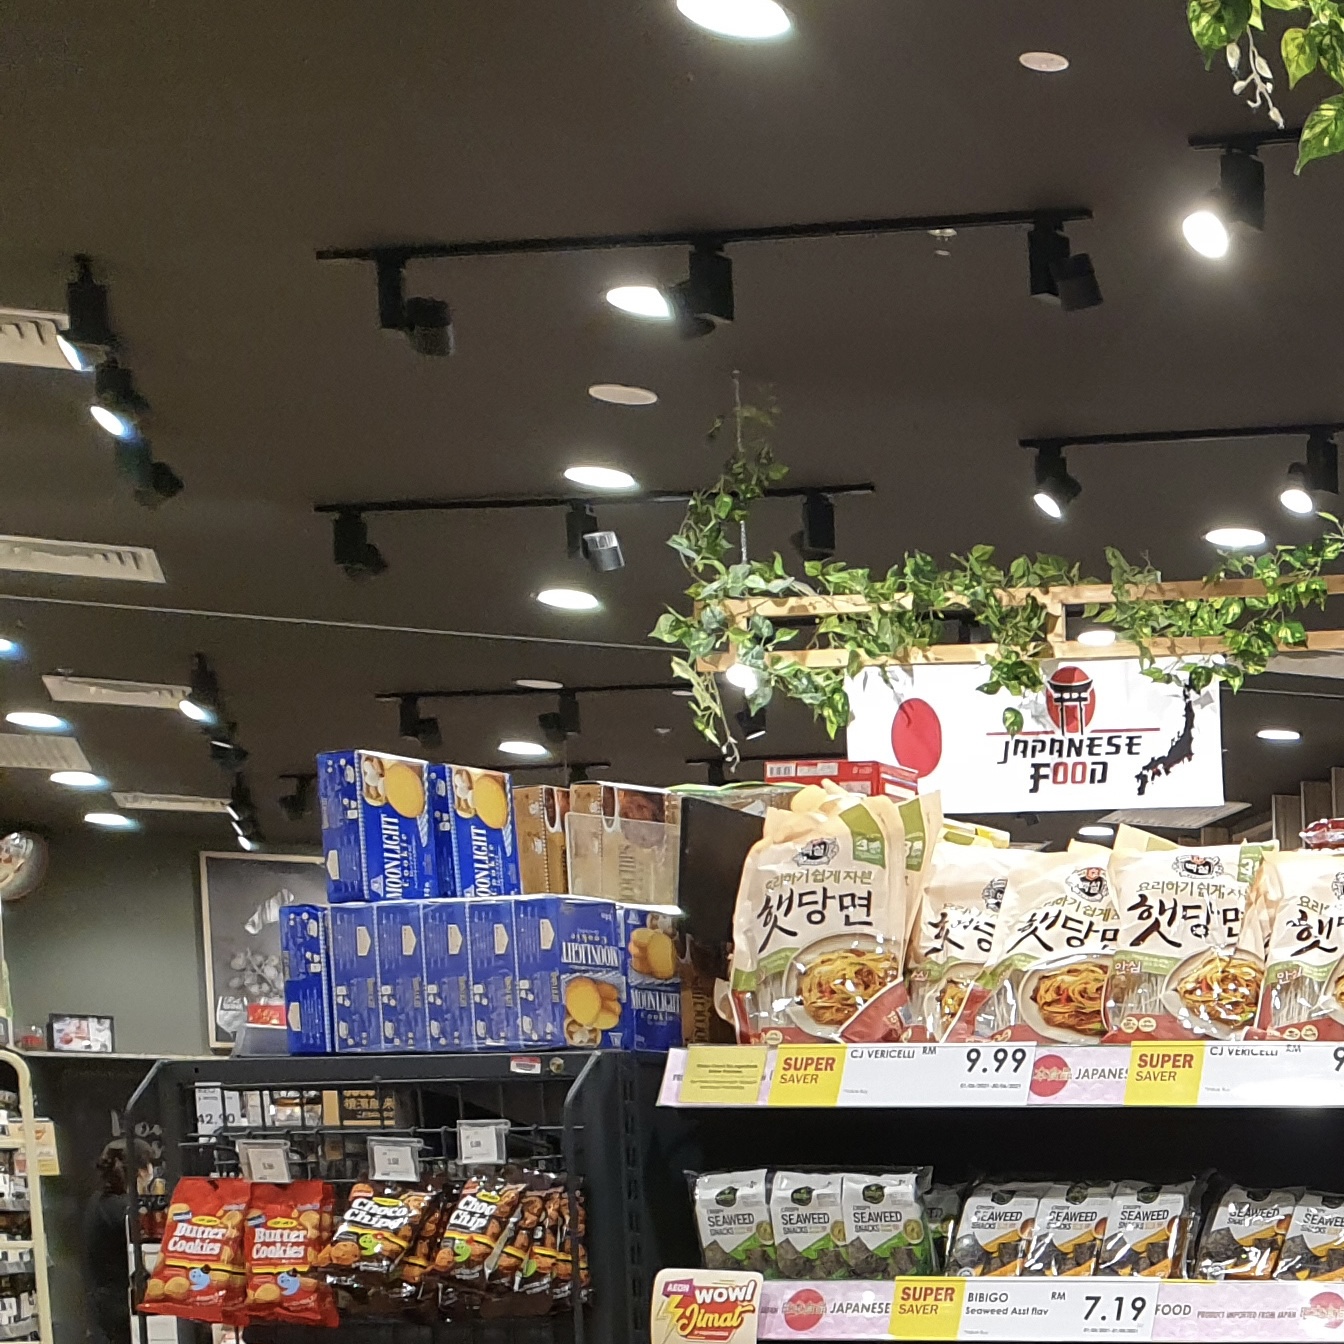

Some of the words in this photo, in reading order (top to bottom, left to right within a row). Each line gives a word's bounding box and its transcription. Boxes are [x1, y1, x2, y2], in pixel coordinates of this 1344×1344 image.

[997, 735, 1142, 764] JAPANESE
[1029, 761, 1108, 793] FOOD
[757, 888, 874, 954] 햇당면
[851, 1049, 864, 1058] CJ
[922, 1046, 937, 1055] RM
[782, 1057, 835, 1071] SUPER
[966, 1048, 1027, 1073] 9.99
[779, 1074, 819, 1085] SAVER
[708, 1212, 755, 1226] SEAWEED
[781, 1212, 830, 1225] SEAWEED
[695, 1280, 755, 1304] WOW!
[901, 1286, 954, 1302] SUPER
[968, 1292, 1008, 1303] BIBIGO
[1051, 1291, 1066, 1300] RM
[830, 1302, 890, 1315] JAPANESE
[898, 1304, 938, 1315] SAVER
[966, 1307, 1008, 1316] Seaweed
[1084, 1296, 1146, 1322] 7.19
[1154, 1304, 1191, 1315] FOOD
